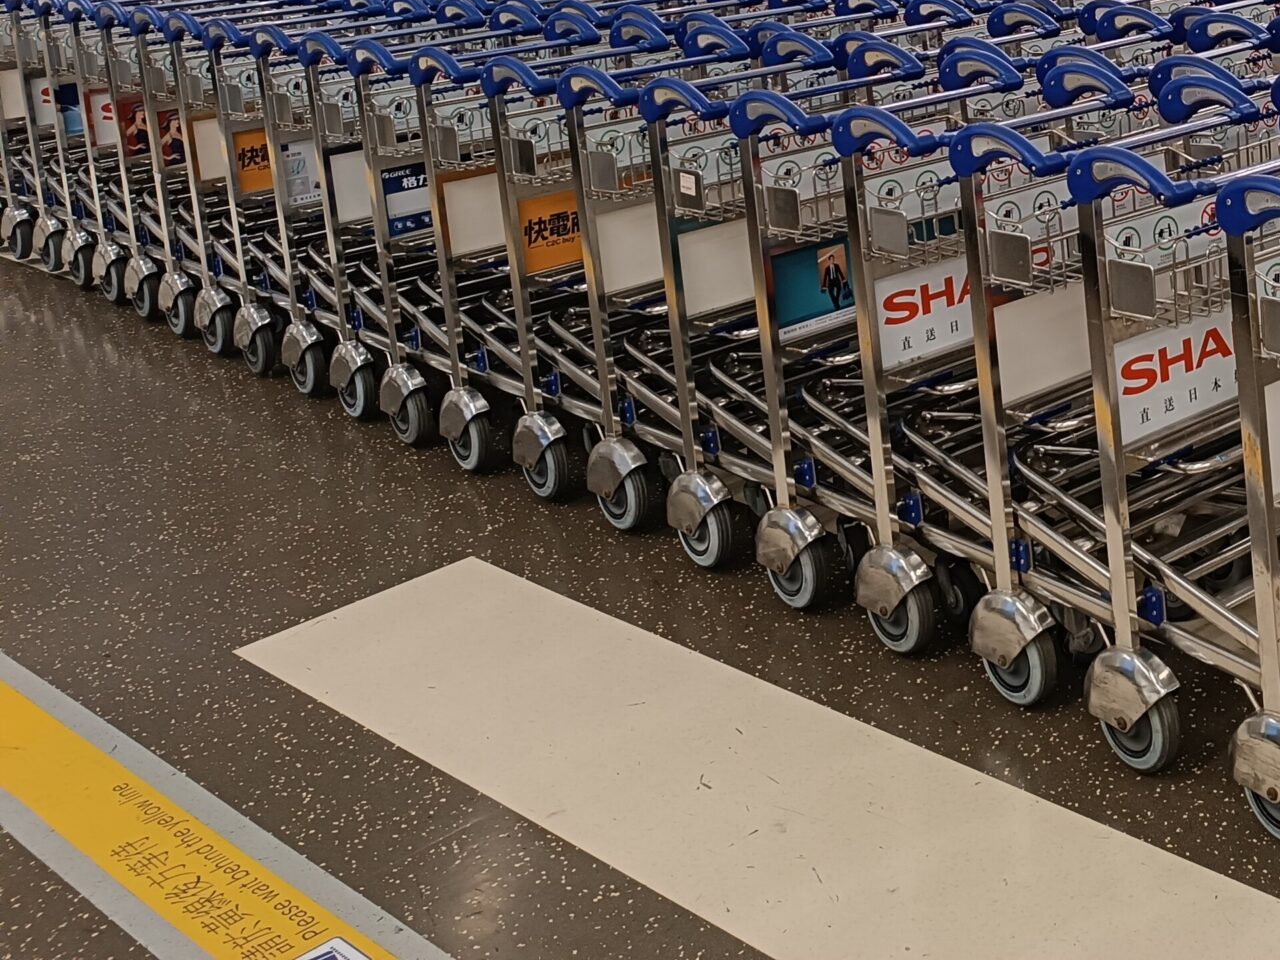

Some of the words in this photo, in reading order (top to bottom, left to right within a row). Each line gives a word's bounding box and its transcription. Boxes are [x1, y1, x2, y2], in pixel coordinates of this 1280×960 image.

[390, 168, 412, 178] GREE
[1120, 326, 1233, 396] SHA
[1139, 369, 1239, 425] 直送日本
[112, 782, 145, 807] line
[137, 798, 190, 834] yellow
[173, 827, 204, 857] the
[196, 843, 252, 886] behind
[240, 876, 281, 904] wait
[272, 898, 330, 942] Please
